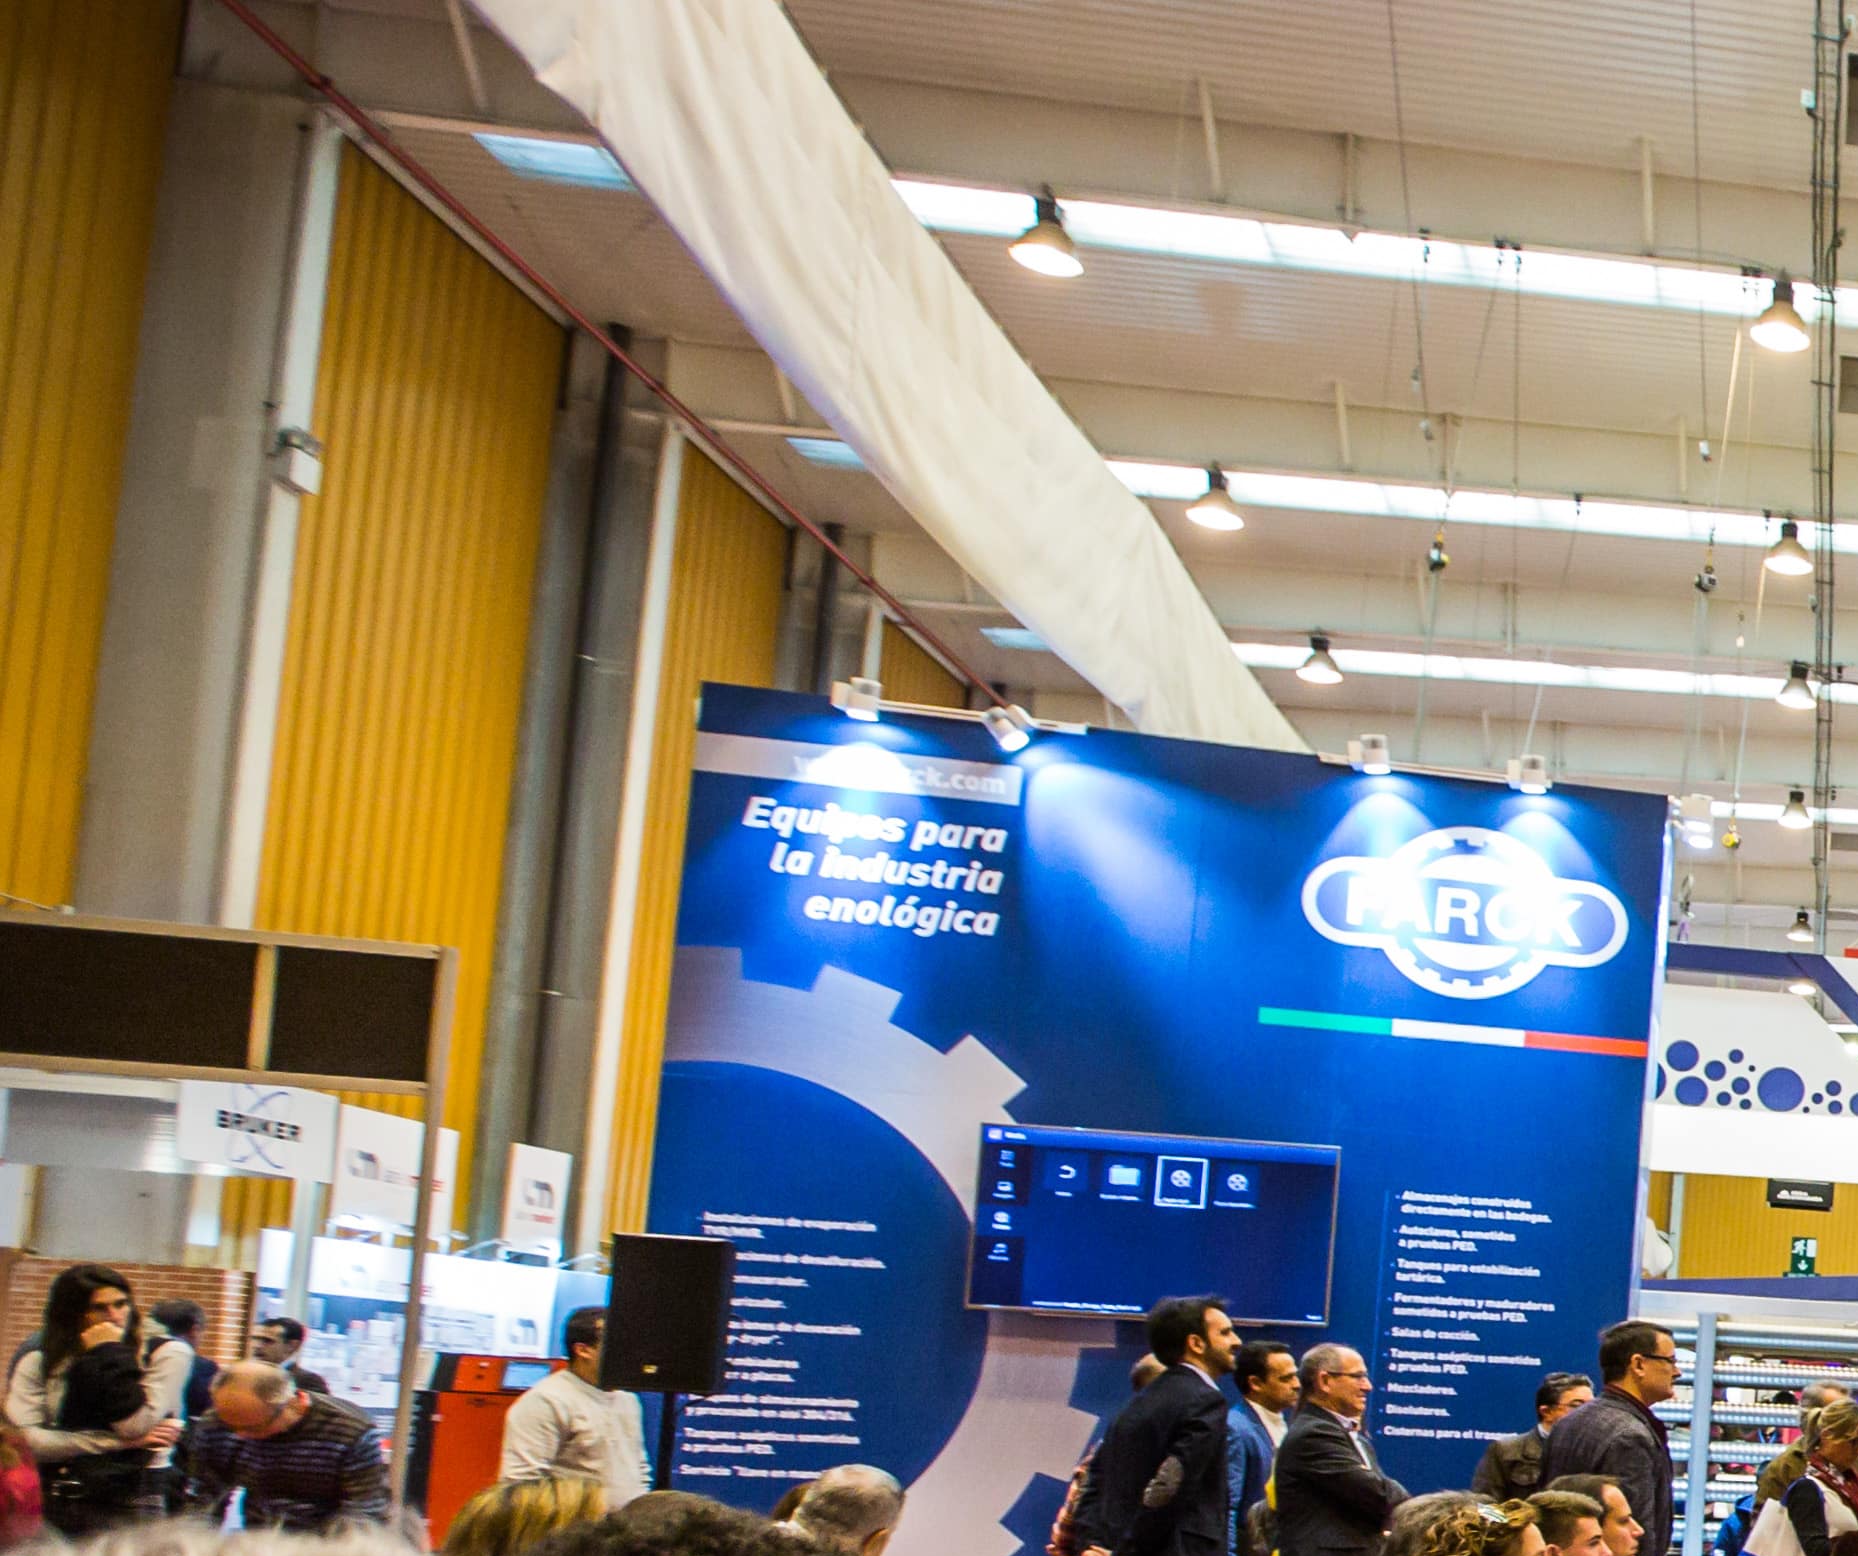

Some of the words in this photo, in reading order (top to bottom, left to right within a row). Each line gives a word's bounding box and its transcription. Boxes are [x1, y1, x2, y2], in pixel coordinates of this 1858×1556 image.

[742, 795, 907, 845] Equipos
[909, 819, 1008, 853] para
[768, 842, 815, 876] la
[818, 845, 1004, 895] industria
[803, 894, 1000, 938] enológica
[216, 1108, 301, 1143] BRUKER
